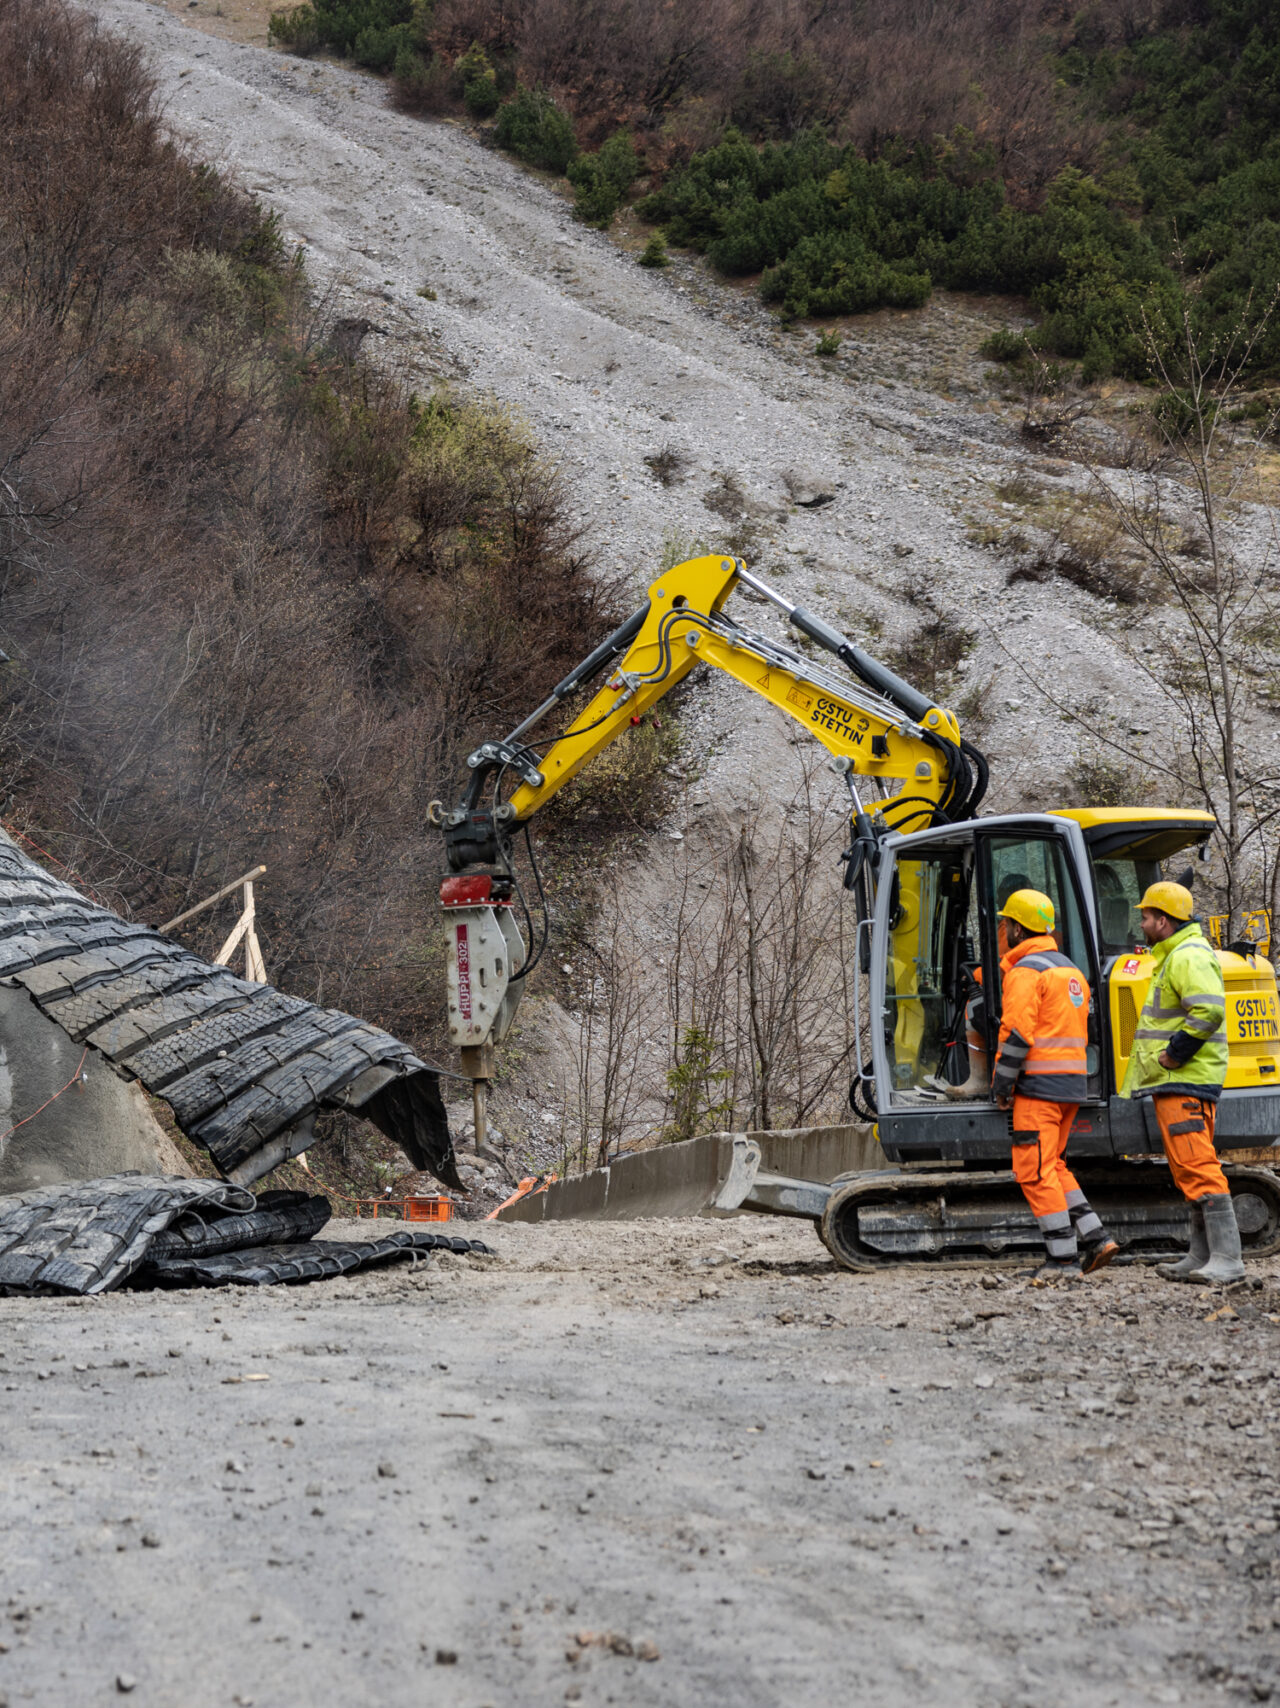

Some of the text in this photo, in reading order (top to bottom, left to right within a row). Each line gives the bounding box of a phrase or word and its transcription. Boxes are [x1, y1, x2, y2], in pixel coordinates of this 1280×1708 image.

[811, 710, 864, 745] STETTIN
[458, 942, 468, 964] 302
[1238, 1020, 1278, 1037] STETTIN
